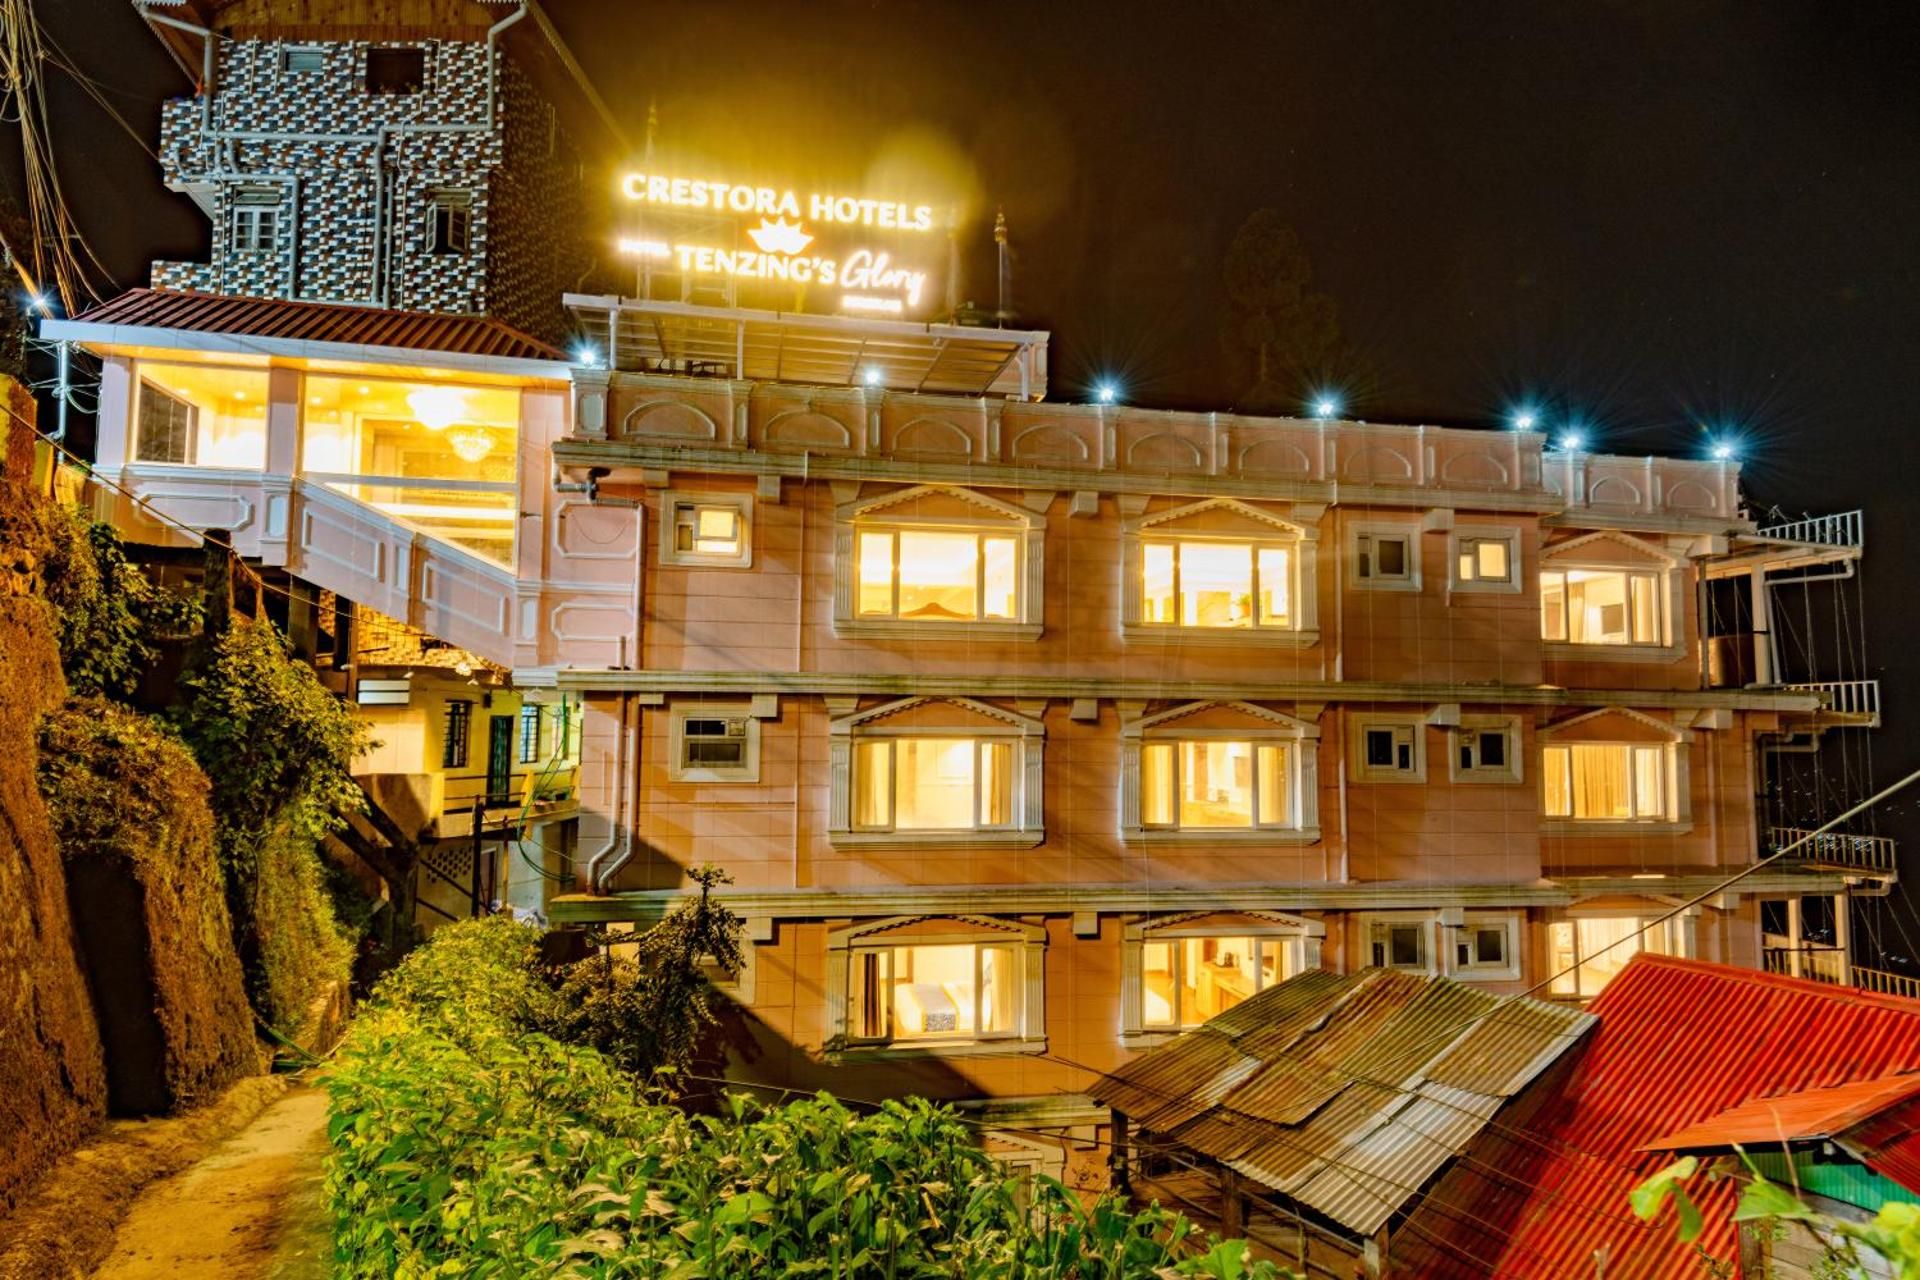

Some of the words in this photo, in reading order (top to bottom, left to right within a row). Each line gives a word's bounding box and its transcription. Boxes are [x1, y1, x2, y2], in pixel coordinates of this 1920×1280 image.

[621, 173, 800, 217] CRESTORA
[810, 193, 932, 231] HOTELS
[676, 245, 836, 285] TENZING'S
[839, 250, 926, 306] Glory
